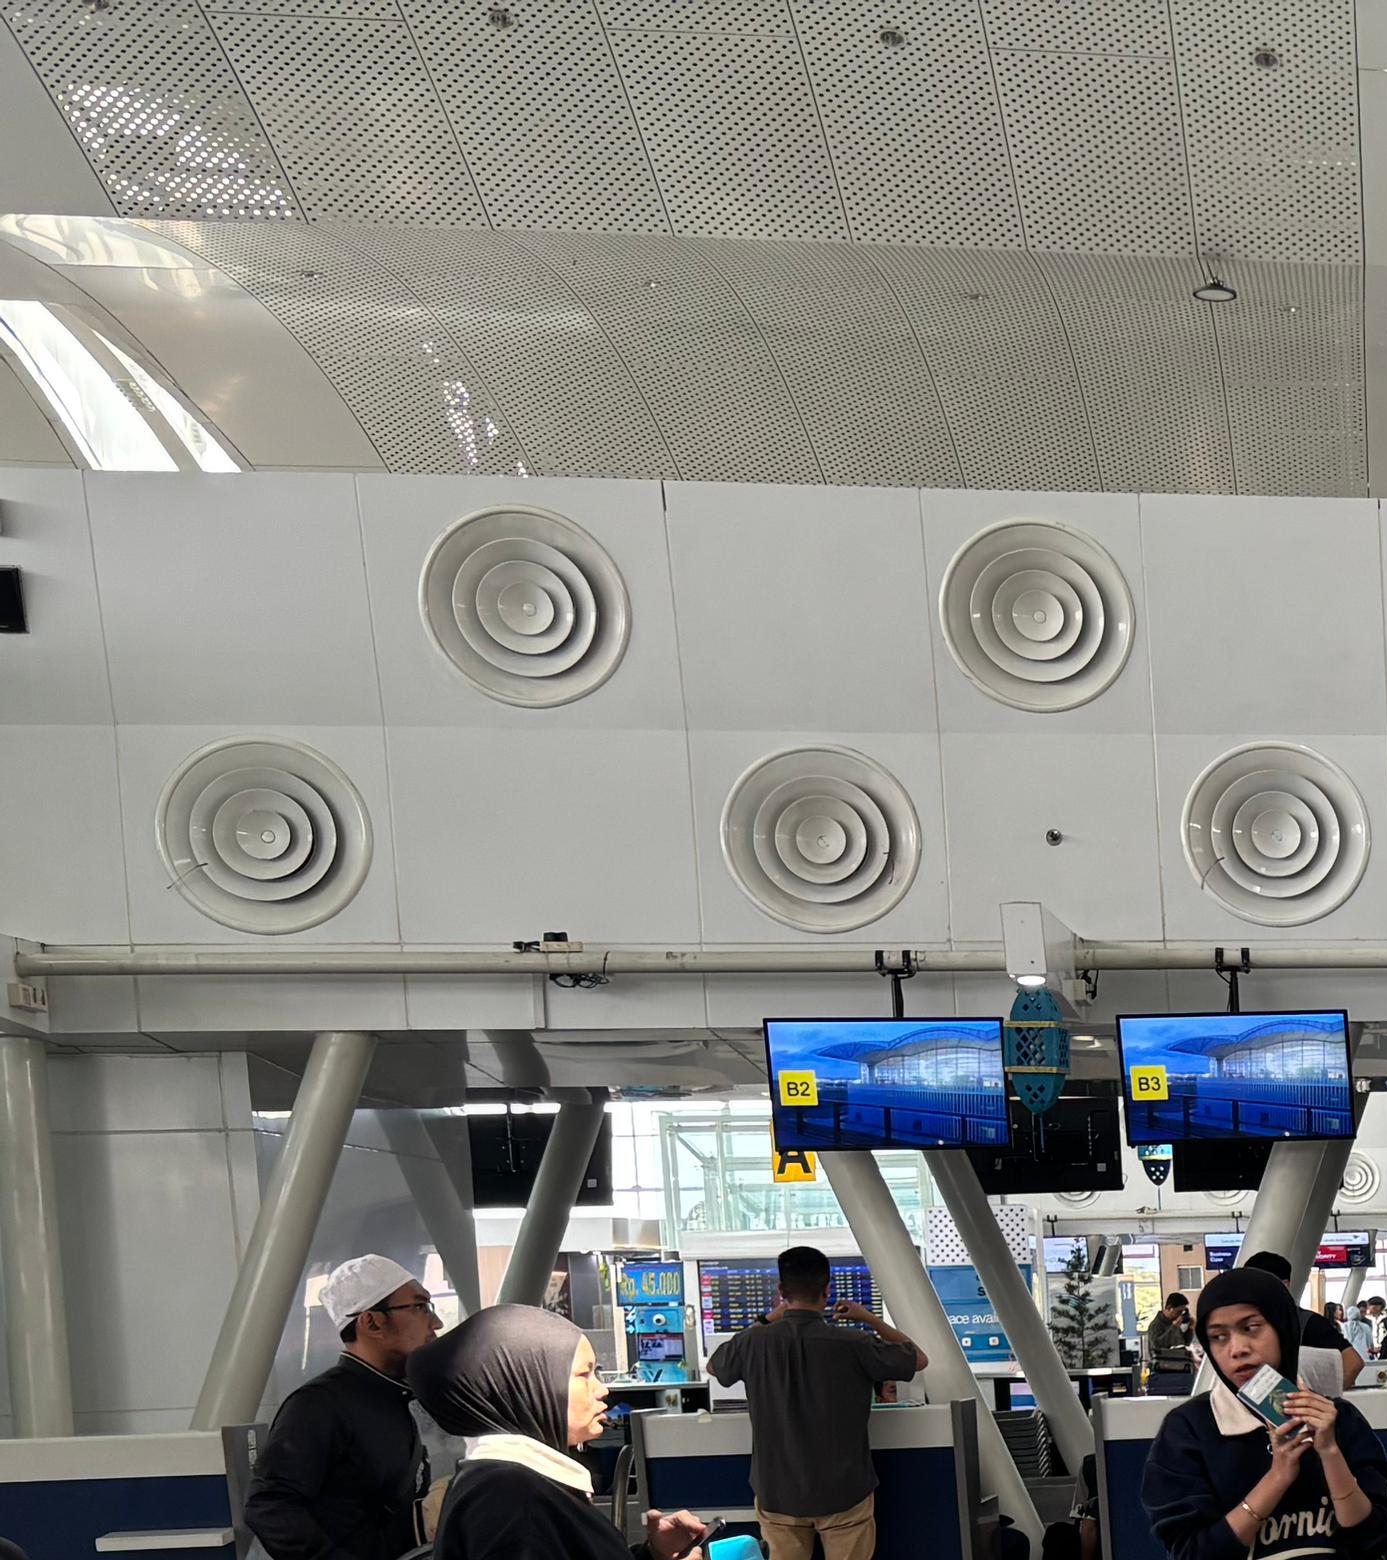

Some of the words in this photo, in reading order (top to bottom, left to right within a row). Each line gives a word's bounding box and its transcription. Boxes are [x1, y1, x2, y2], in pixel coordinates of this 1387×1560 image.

[786, 1077, 811, 1097] B2
[1137, 1074, 1162, 1093] B3
[777, 1150, 812, 1175] A
